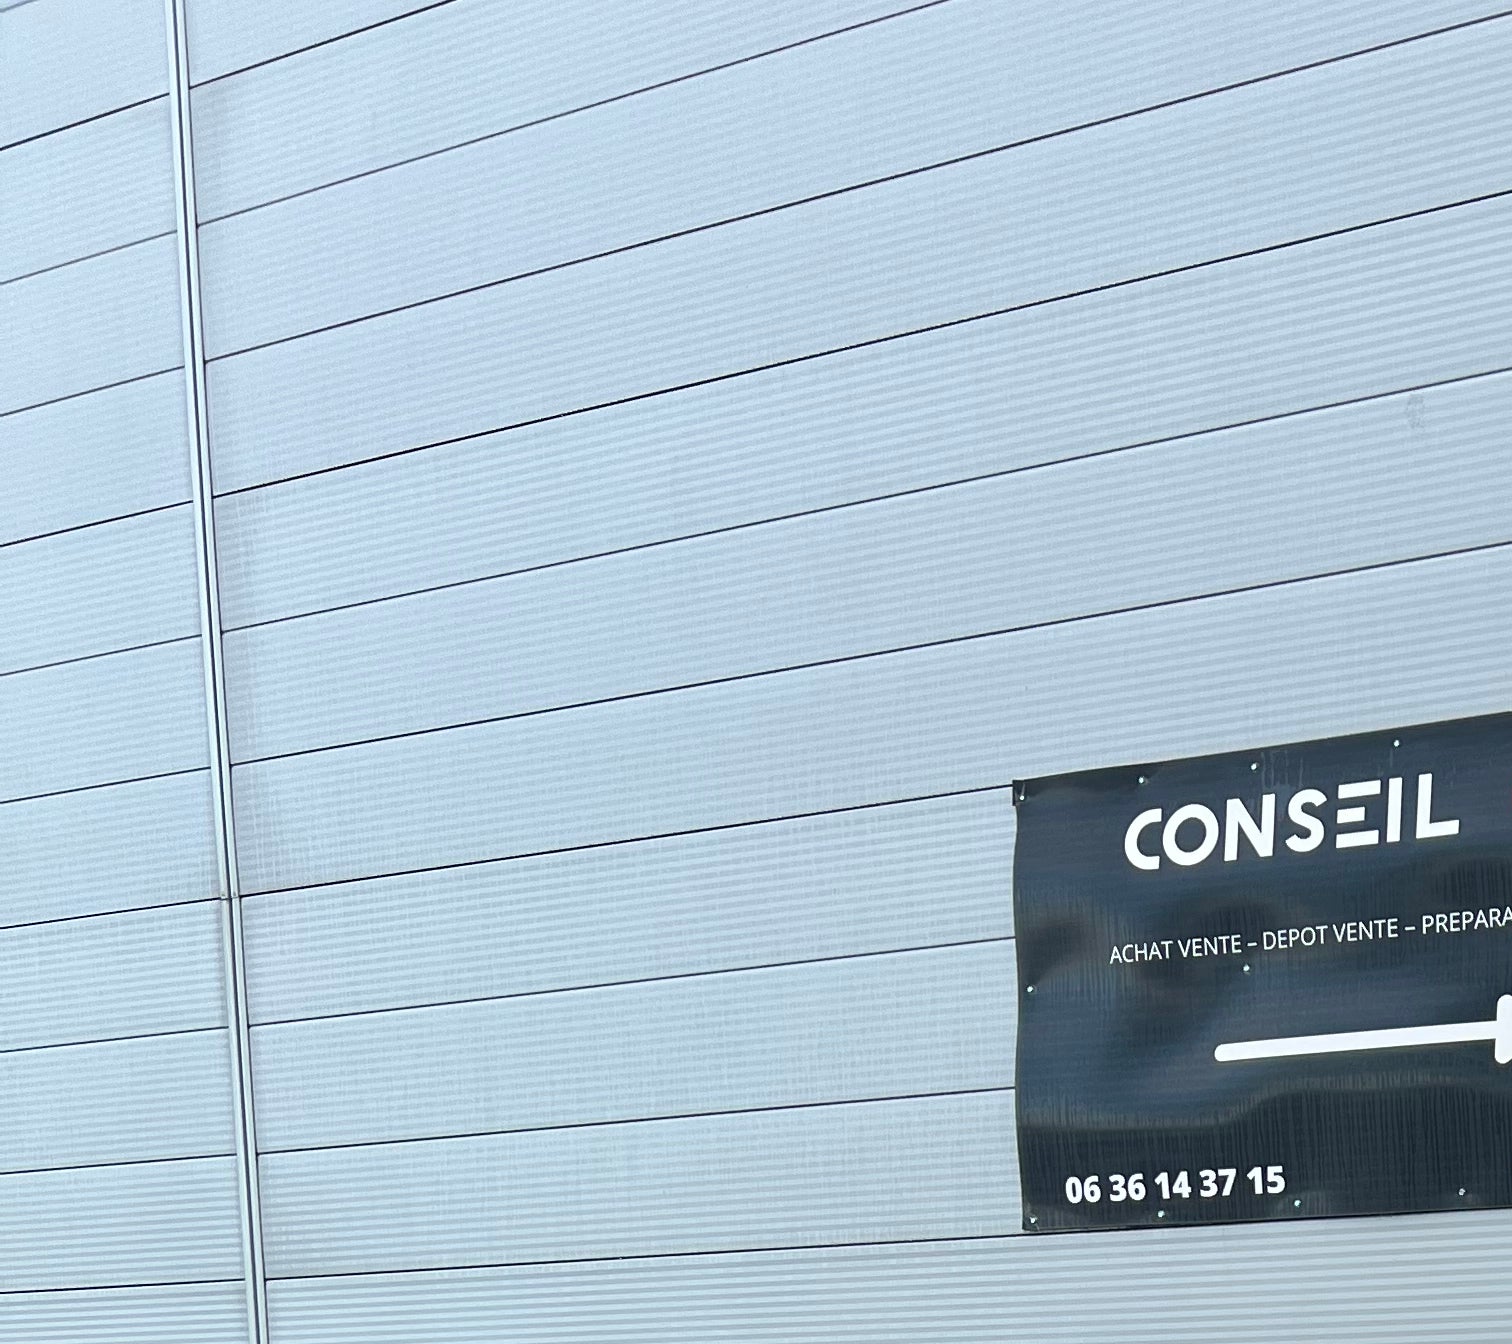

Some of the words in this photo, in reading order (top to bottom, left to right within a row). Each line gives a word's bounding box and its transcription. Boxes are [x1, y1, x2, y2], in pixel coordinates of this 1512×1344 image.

[1124, 772, 1460, 871] CONSEIL
[1109, 940, 1174, 965] ACHAT
[1177, 934, 1242, 958] VENTE
[1262, 925, 1329, 951] DEPOT
[1332, 918, 1399, 943] VENTE
[1065, 1175, 1102, 1204] 06
[1108, 1172, 1146, 1202] 36
[1154, 1170, 1192, 1200] 14
[1199, 1168, 1237, 1198] 37
[1246, 1165, 1286, 1195] 15
